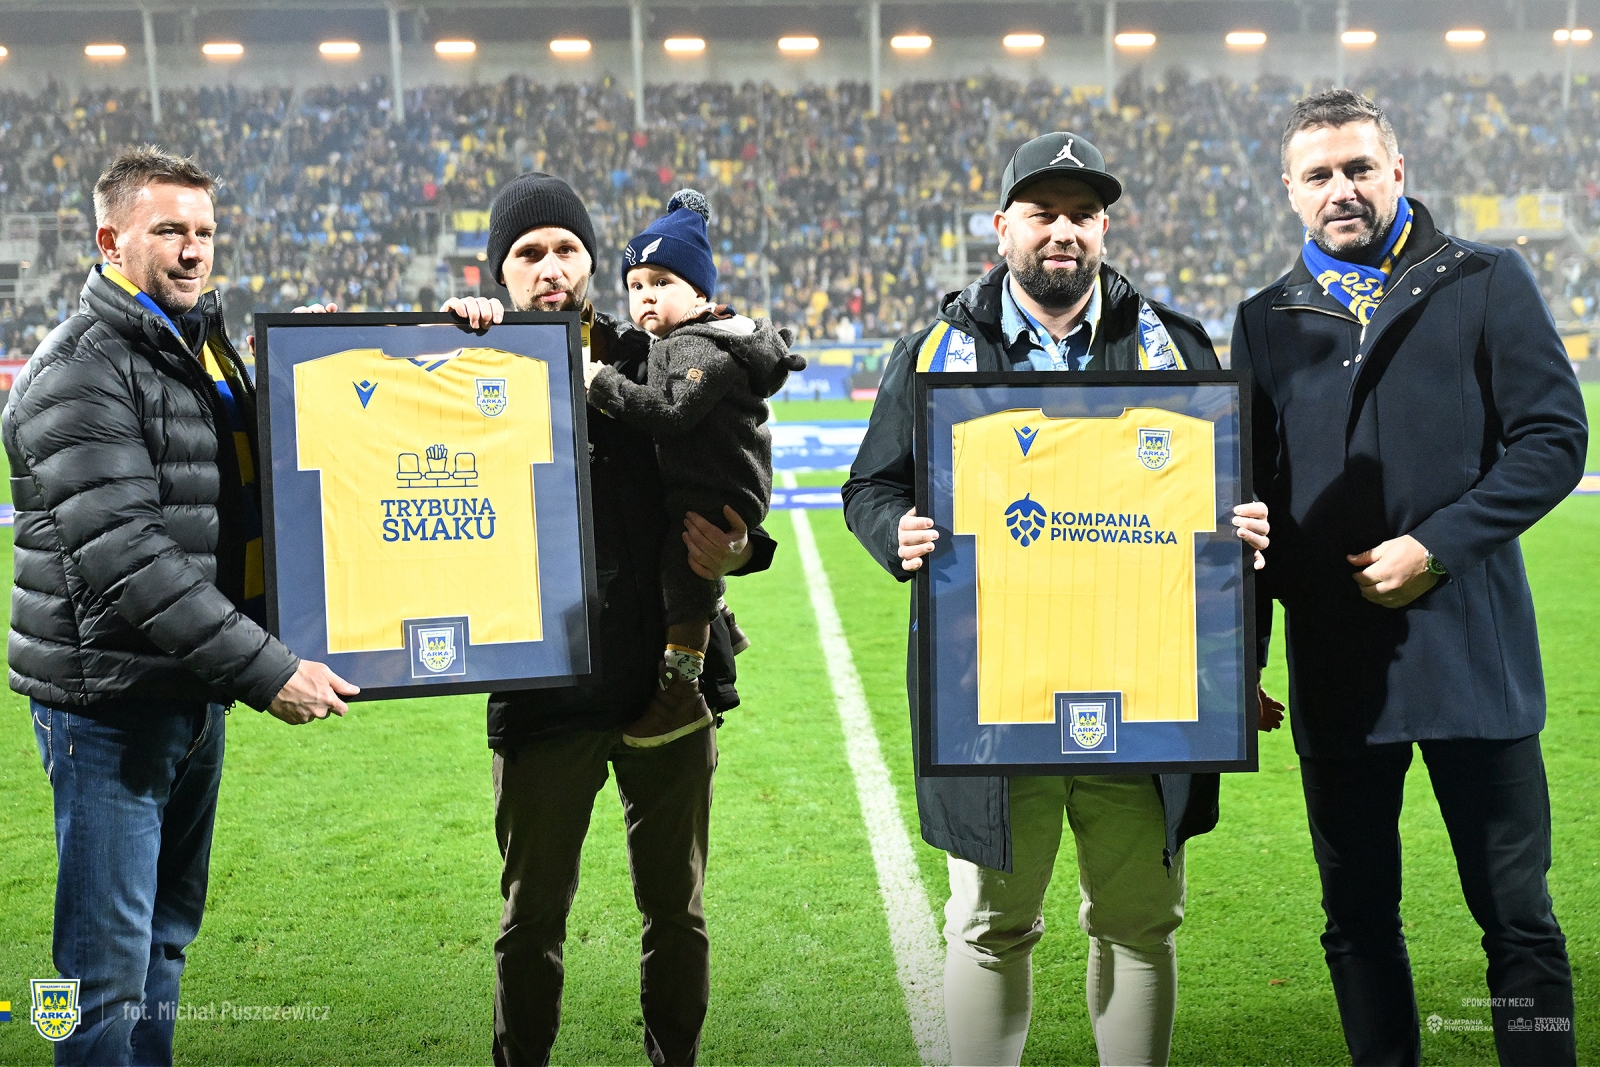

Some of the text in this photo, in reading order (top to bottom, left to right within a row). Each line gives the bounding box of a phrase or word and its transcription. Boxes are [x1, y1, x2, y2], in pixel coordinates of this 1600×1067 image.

[380, 497, 496, 517] TRYBUNA
[382, 516, 496, 542] SMAKU
[1051, 511, 1151, 528] KOMPANIA
[1050, 527, 1178, 545] PIWOWARSKA
